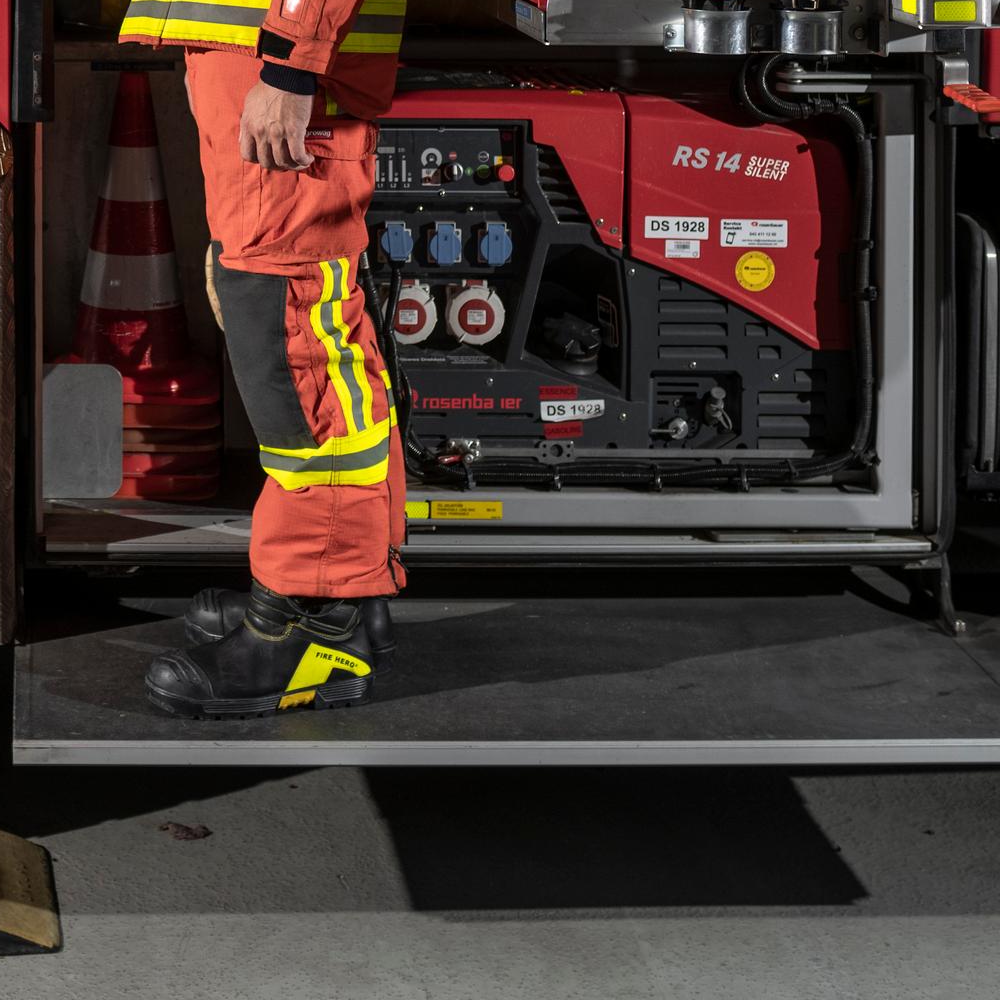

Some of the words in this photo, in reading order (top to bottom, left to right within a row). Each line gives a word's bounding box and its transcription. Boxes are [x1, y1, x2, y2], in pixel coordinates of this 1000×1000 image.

[672, 145, 711, 169] RS
[715, 151, 743, 173] 14
[748, 155, 790, 172] SUPER
[744, 165, 788, 182] SILENT
[651, 220, 670, 232] DS
[675, 221, 705, 233] 1928
[547, 405, 566, 416] DS
[570, 404, 601, 415] 1928
[316, 651, 333, 661] FIRE
